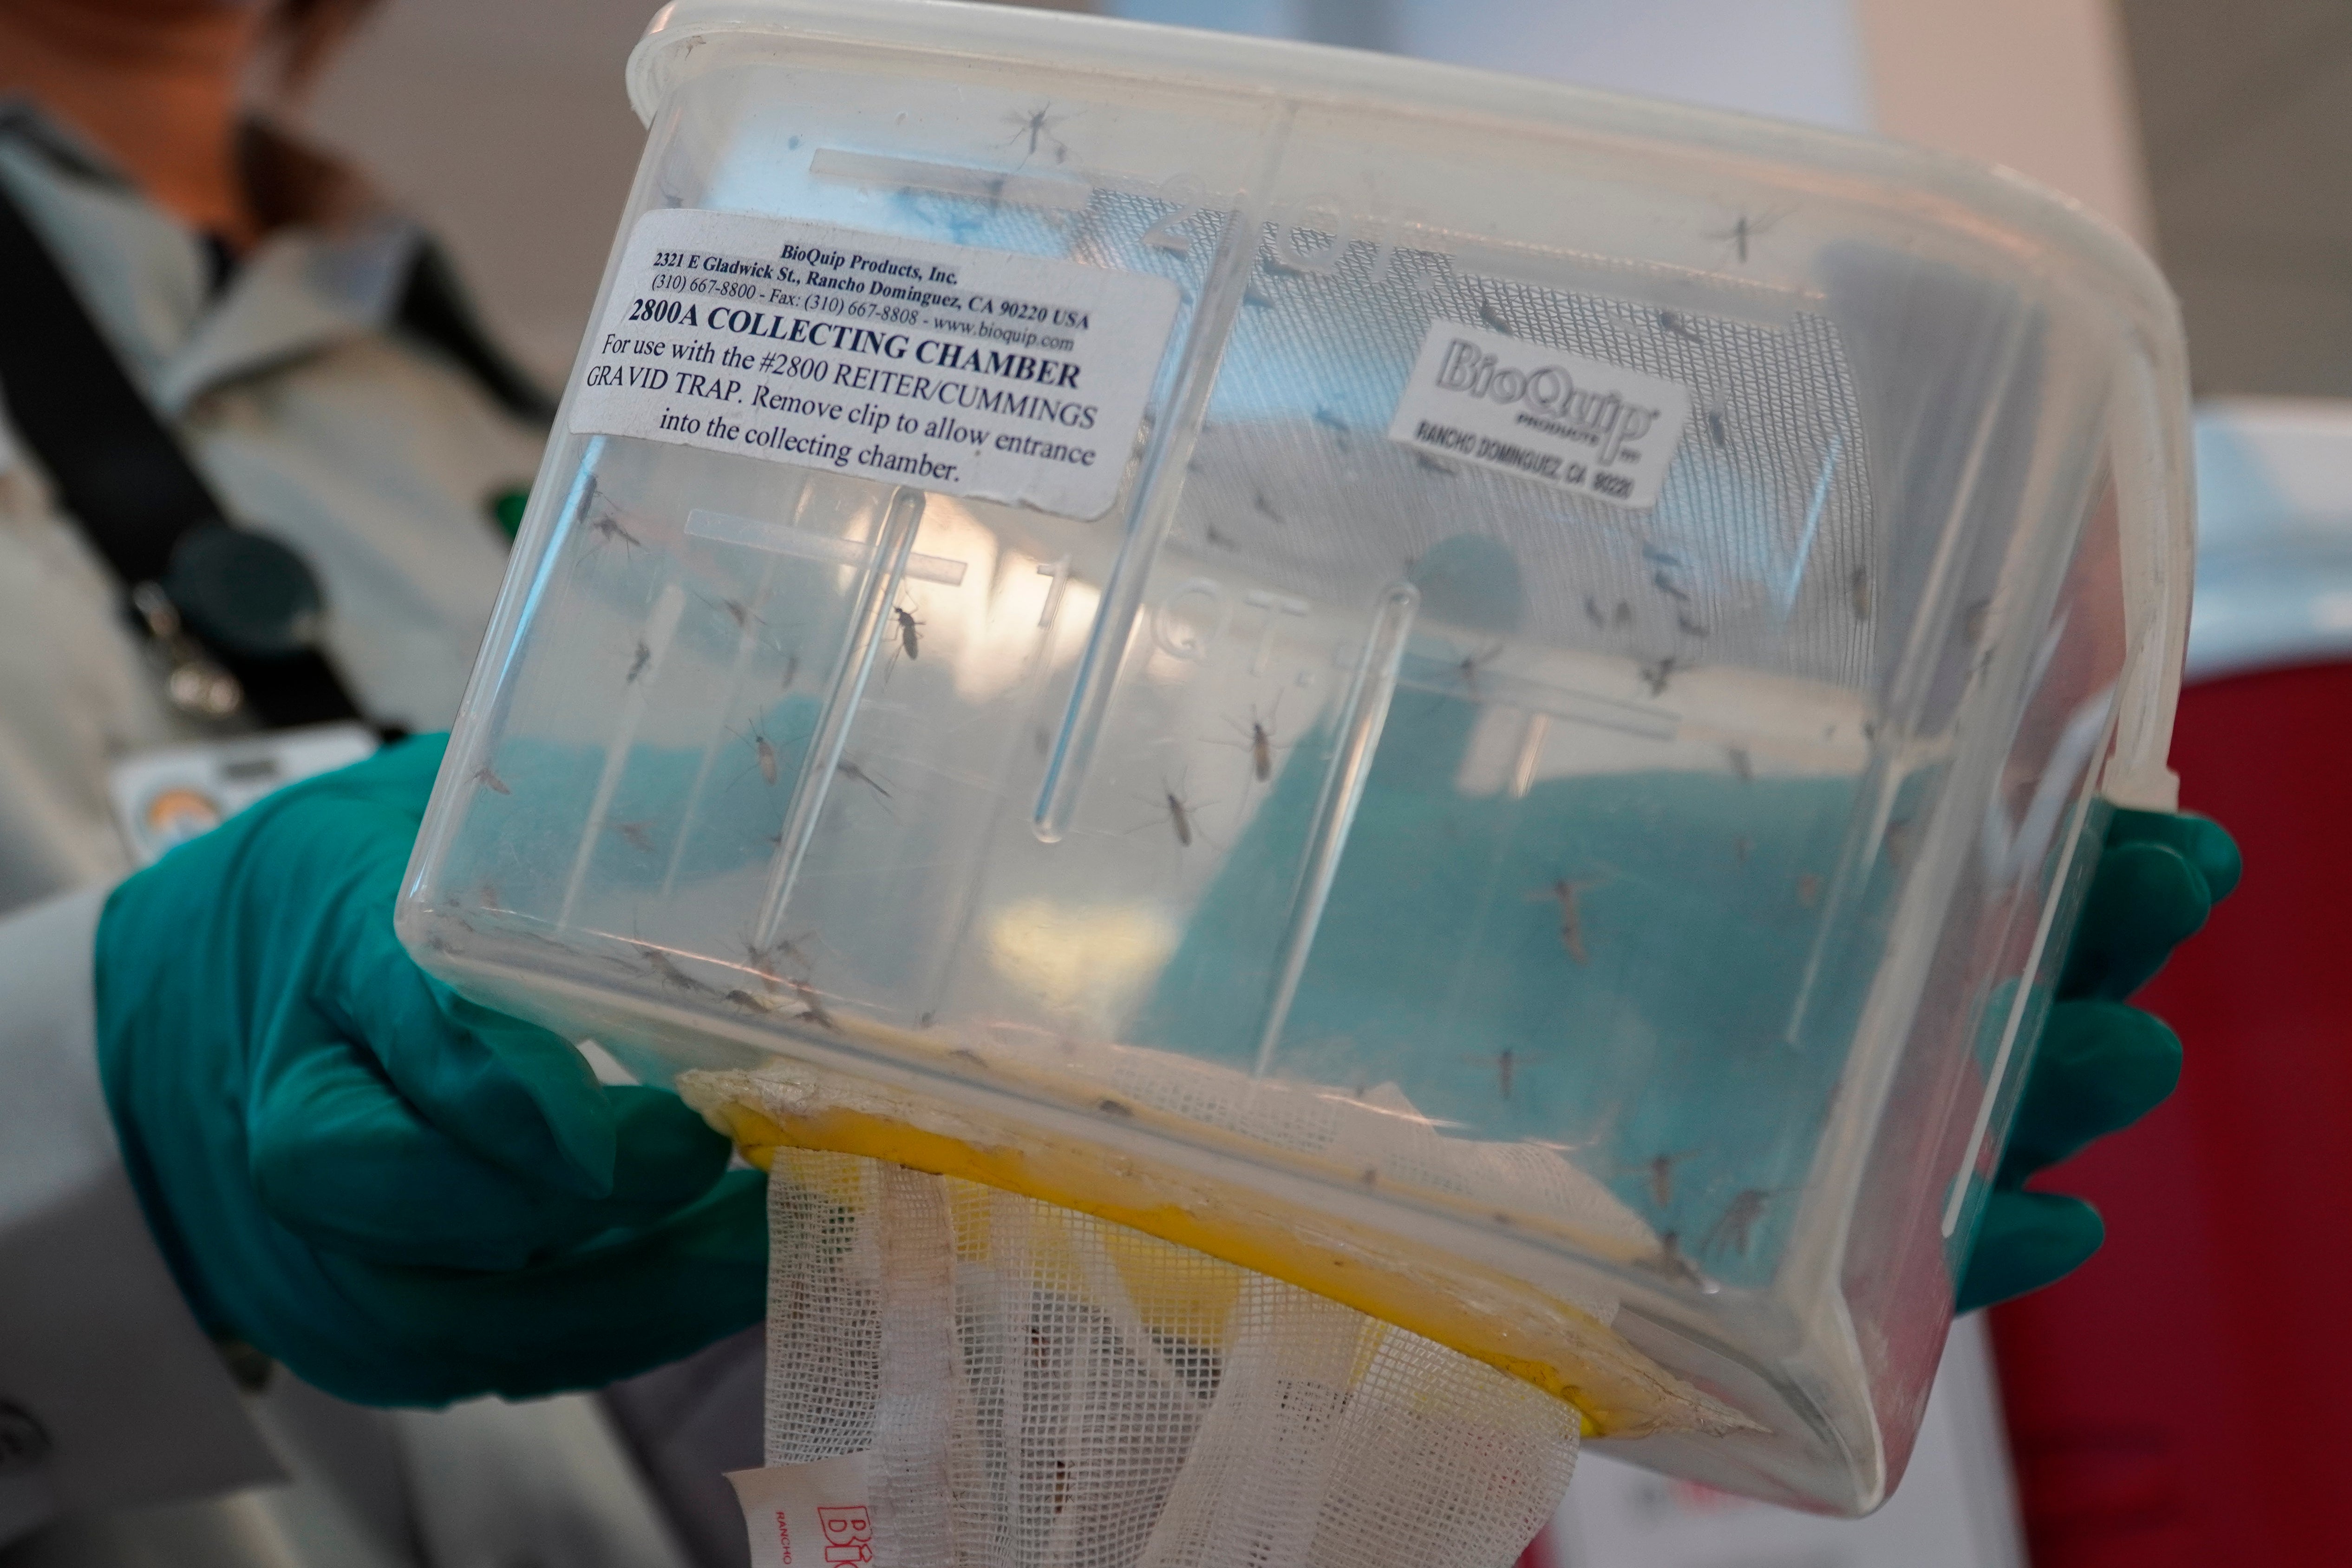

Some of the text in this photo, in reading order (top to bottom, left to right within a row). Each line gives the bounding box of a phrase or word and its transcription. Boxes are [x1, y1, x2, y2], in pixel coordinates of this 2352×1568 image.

[653, 253, 1089, 329] 2321 E Gladwick St., Rancho Dominguez, CA 90220 USA
[780, 245, 958, 285] BioQuip Products, Inc.
[629, 299, 1081, 389] 2800A COLLECTING CHAMBER
[652, 274, 686, 292] (310)
[690, 278, 756, 299] 667-8800
[770, 289, 801, 307] Fax:
[804, 295, 843, 316] (310)
[848, 301, 919, 324] 667-8808
[934, 317, 1074, 352] www.bioquip.com
[587, 366, 1096, 466] GRAVID TRAP. Remove clip to allow entrance
[602, 334, 1098, 429] For use with the #2800 REITER/CUMMINGS
[1436, 338, 1653, 466] BioQuip
[660, 407, 959, 482] into the collecting chamber.
[1416, 419, 1477, 455] RANCHO
[1477, 438, 1563, 480] DOMINGUEZ
[1565, 463, 1587, 484] CA
[776, 1511, 792, 1565] RANCHO
[817, 1505, 873, 1568] Bi
